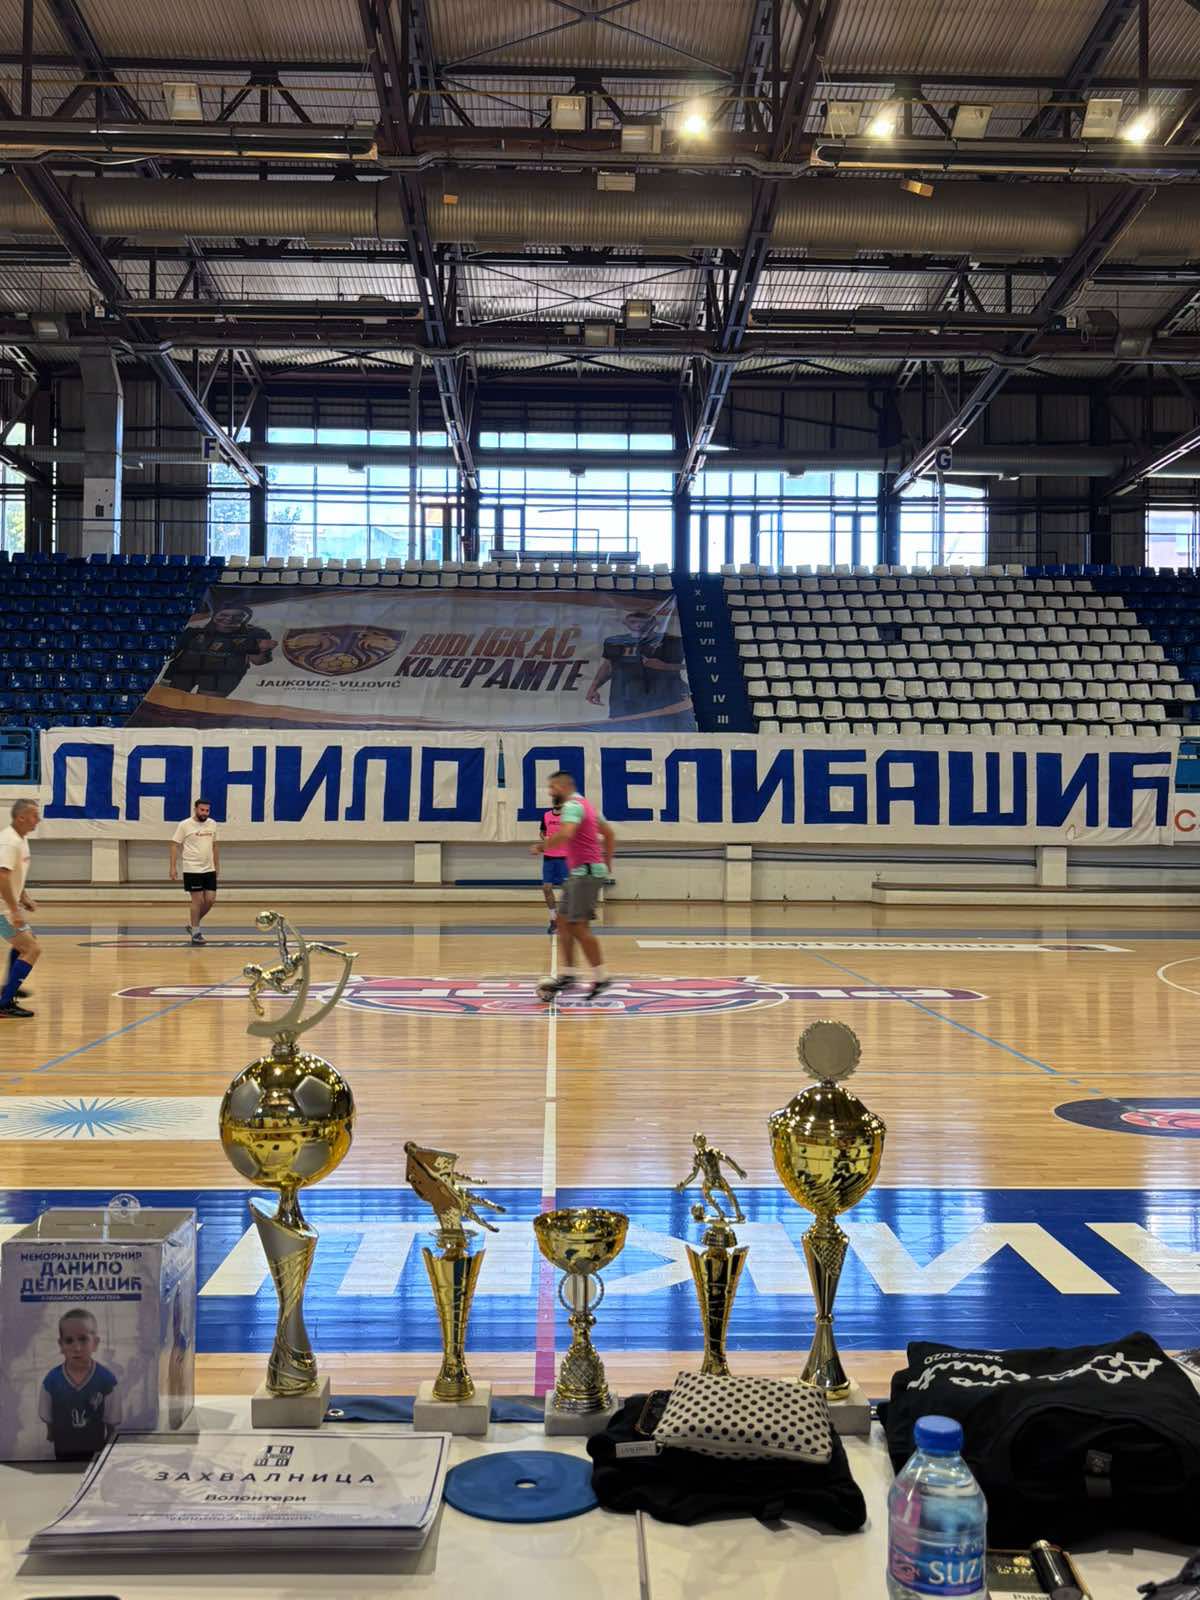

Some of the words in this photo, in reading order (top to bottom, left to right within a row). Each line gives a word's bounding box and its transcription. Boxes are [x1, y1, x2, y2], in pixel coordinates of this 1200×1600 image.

[204, 437, 217, 459] F
[936, 448, 952, 470] G
[695, 620, 713, 629] VIII
[408, 632, 475, 657] BUDI
[699, 638, 716, 646] VII
[703, 656, 718, 664] VI
[394, 655, 473, 679] KOJEG
[460, 658, 590, 692] PAMTE
[710, 674, 720, 683] V
[713, 694, 726, 704] IV
[717, 715, 729, 725] III
[44, 742, 486, 823] ДАНИЛО
[516, 745, 1172, 828] ДЕЛИБАШИЋ
[20, 1252, 100, 1262] МЕМОРИЈАЛНИ
[102, 1251, 143, 1260] ТУРНИР
[41, 1261, 123, 1277] ДАНИЛО
[20, 1277, 143, 1293] ДЕЛИБАШИЋ
[154, 1471, 376, 1485] ЗАХВАЛНИЦА
[204, 1493, 308, 1503] Волонтери
[928, 1558, 981, 1585] SUZ
